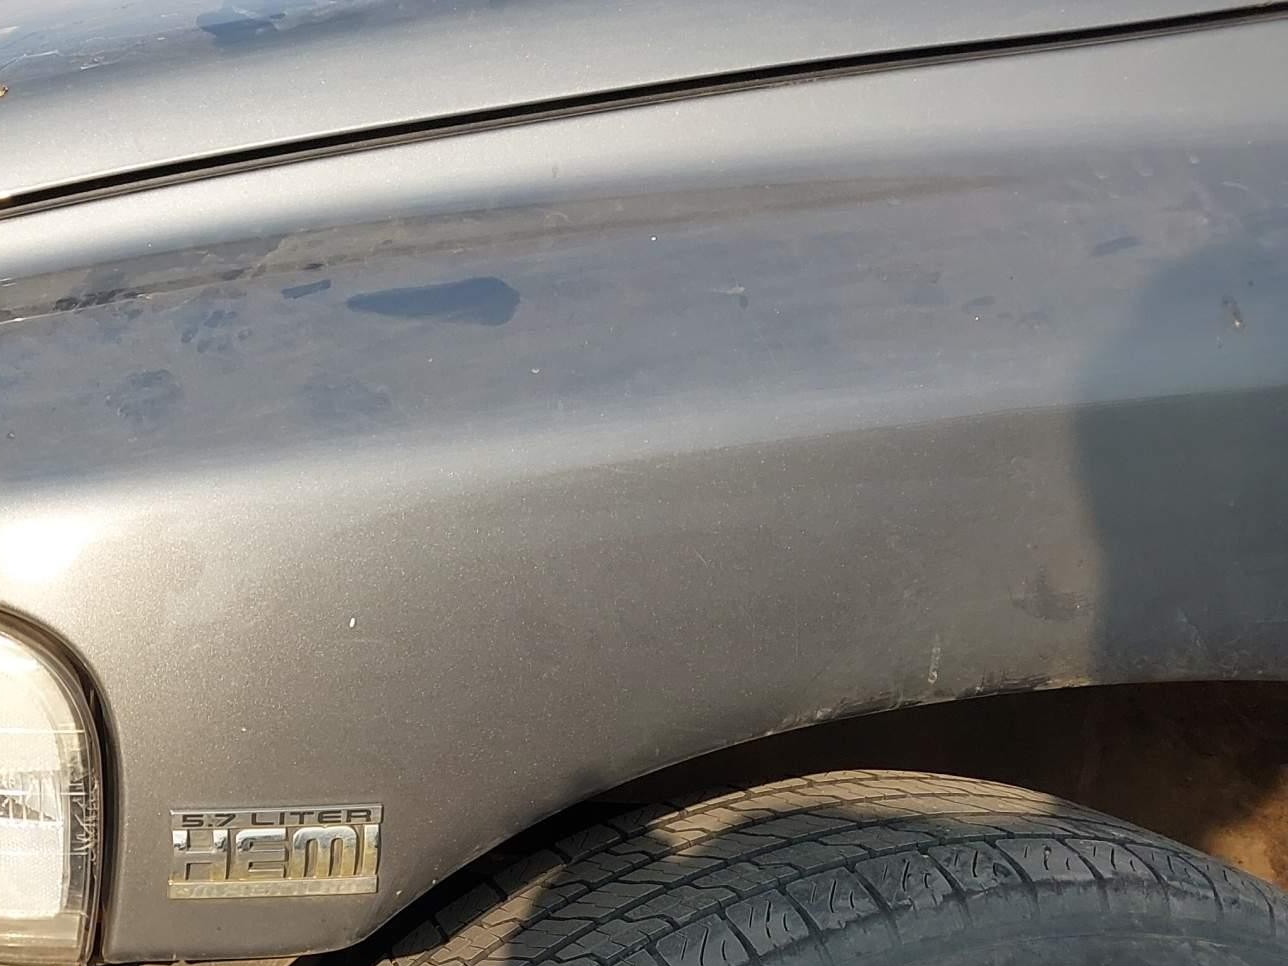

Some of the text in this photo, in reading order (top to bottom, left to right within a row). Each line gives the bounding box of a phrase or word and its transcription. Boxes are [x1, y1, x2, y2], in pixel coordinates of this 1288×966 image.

[181, 809, 372, 828] 5.7 LITER
[171, 824, 380, 880] HEMI
